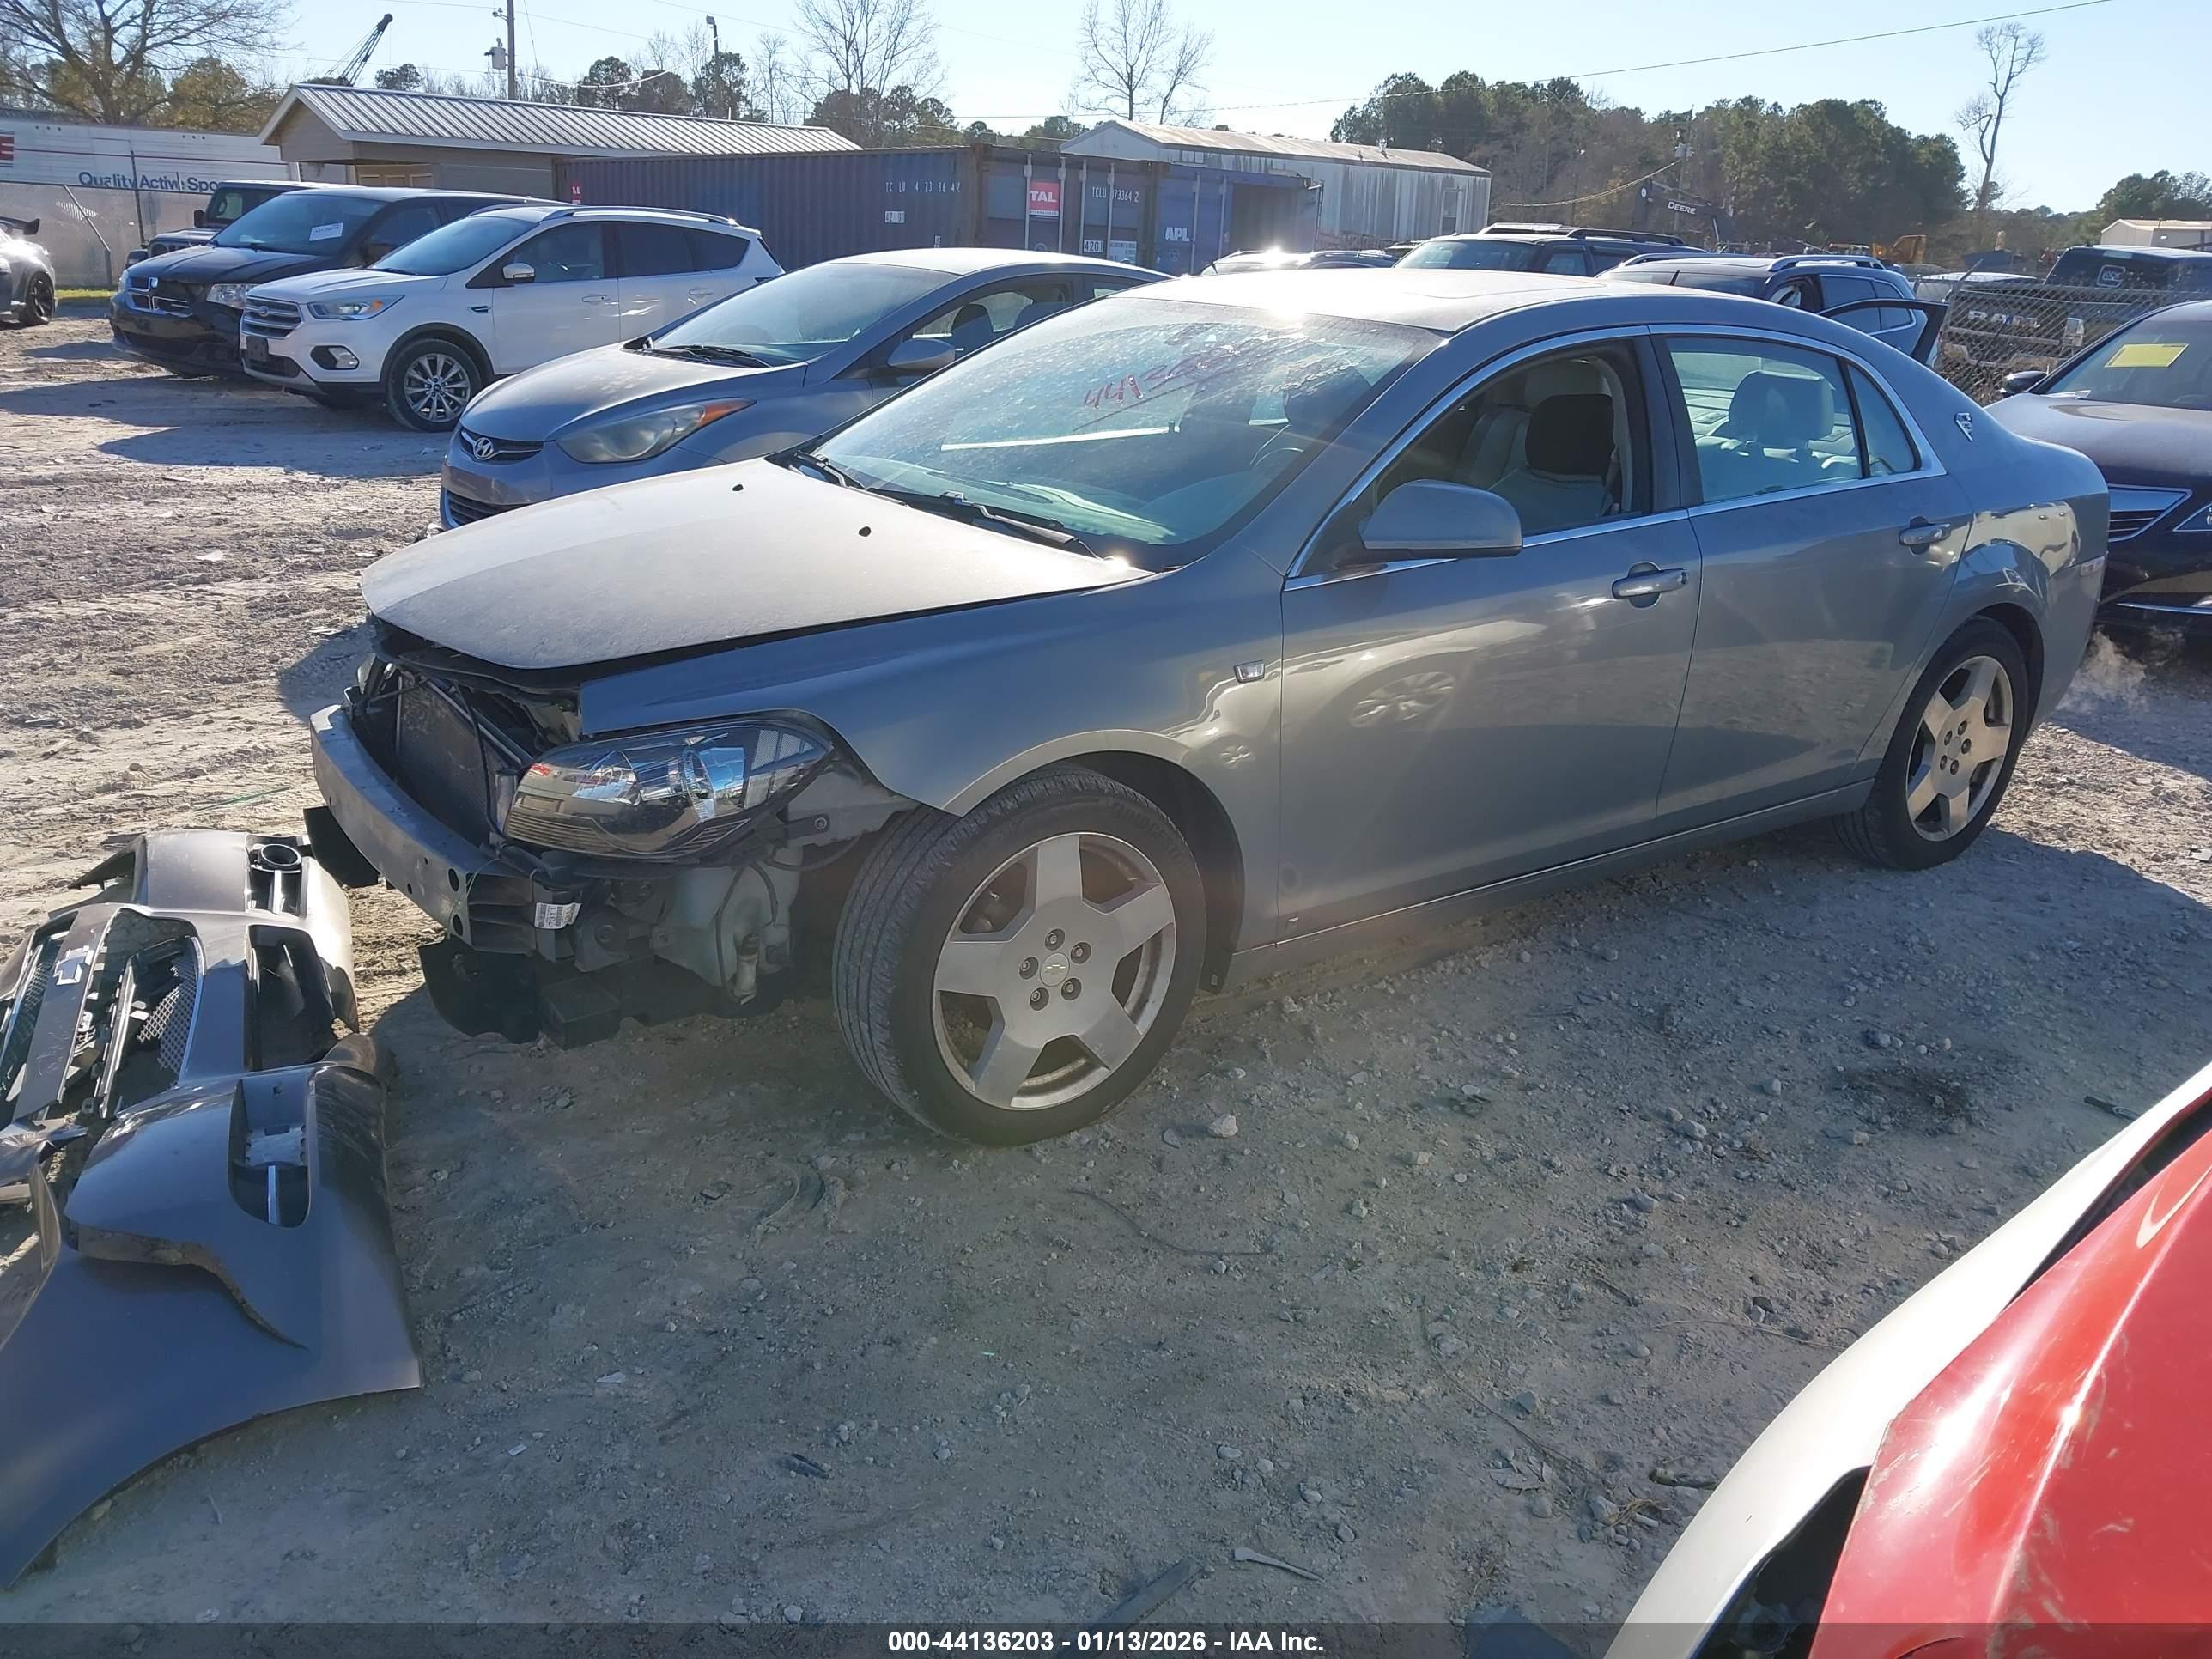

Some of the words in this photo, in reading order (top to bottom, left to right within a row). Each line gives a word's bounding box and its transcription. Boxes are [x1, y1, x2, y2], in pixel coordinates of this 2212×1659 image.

[79, 172, 137, 189] Quality
[1030, 190, 1057, 203] TAL
[1091, 185, 1107, 198] TCLU
[1668, 201, 1697, 215] DEERE
[1165, 227, 1190, 241] APL
